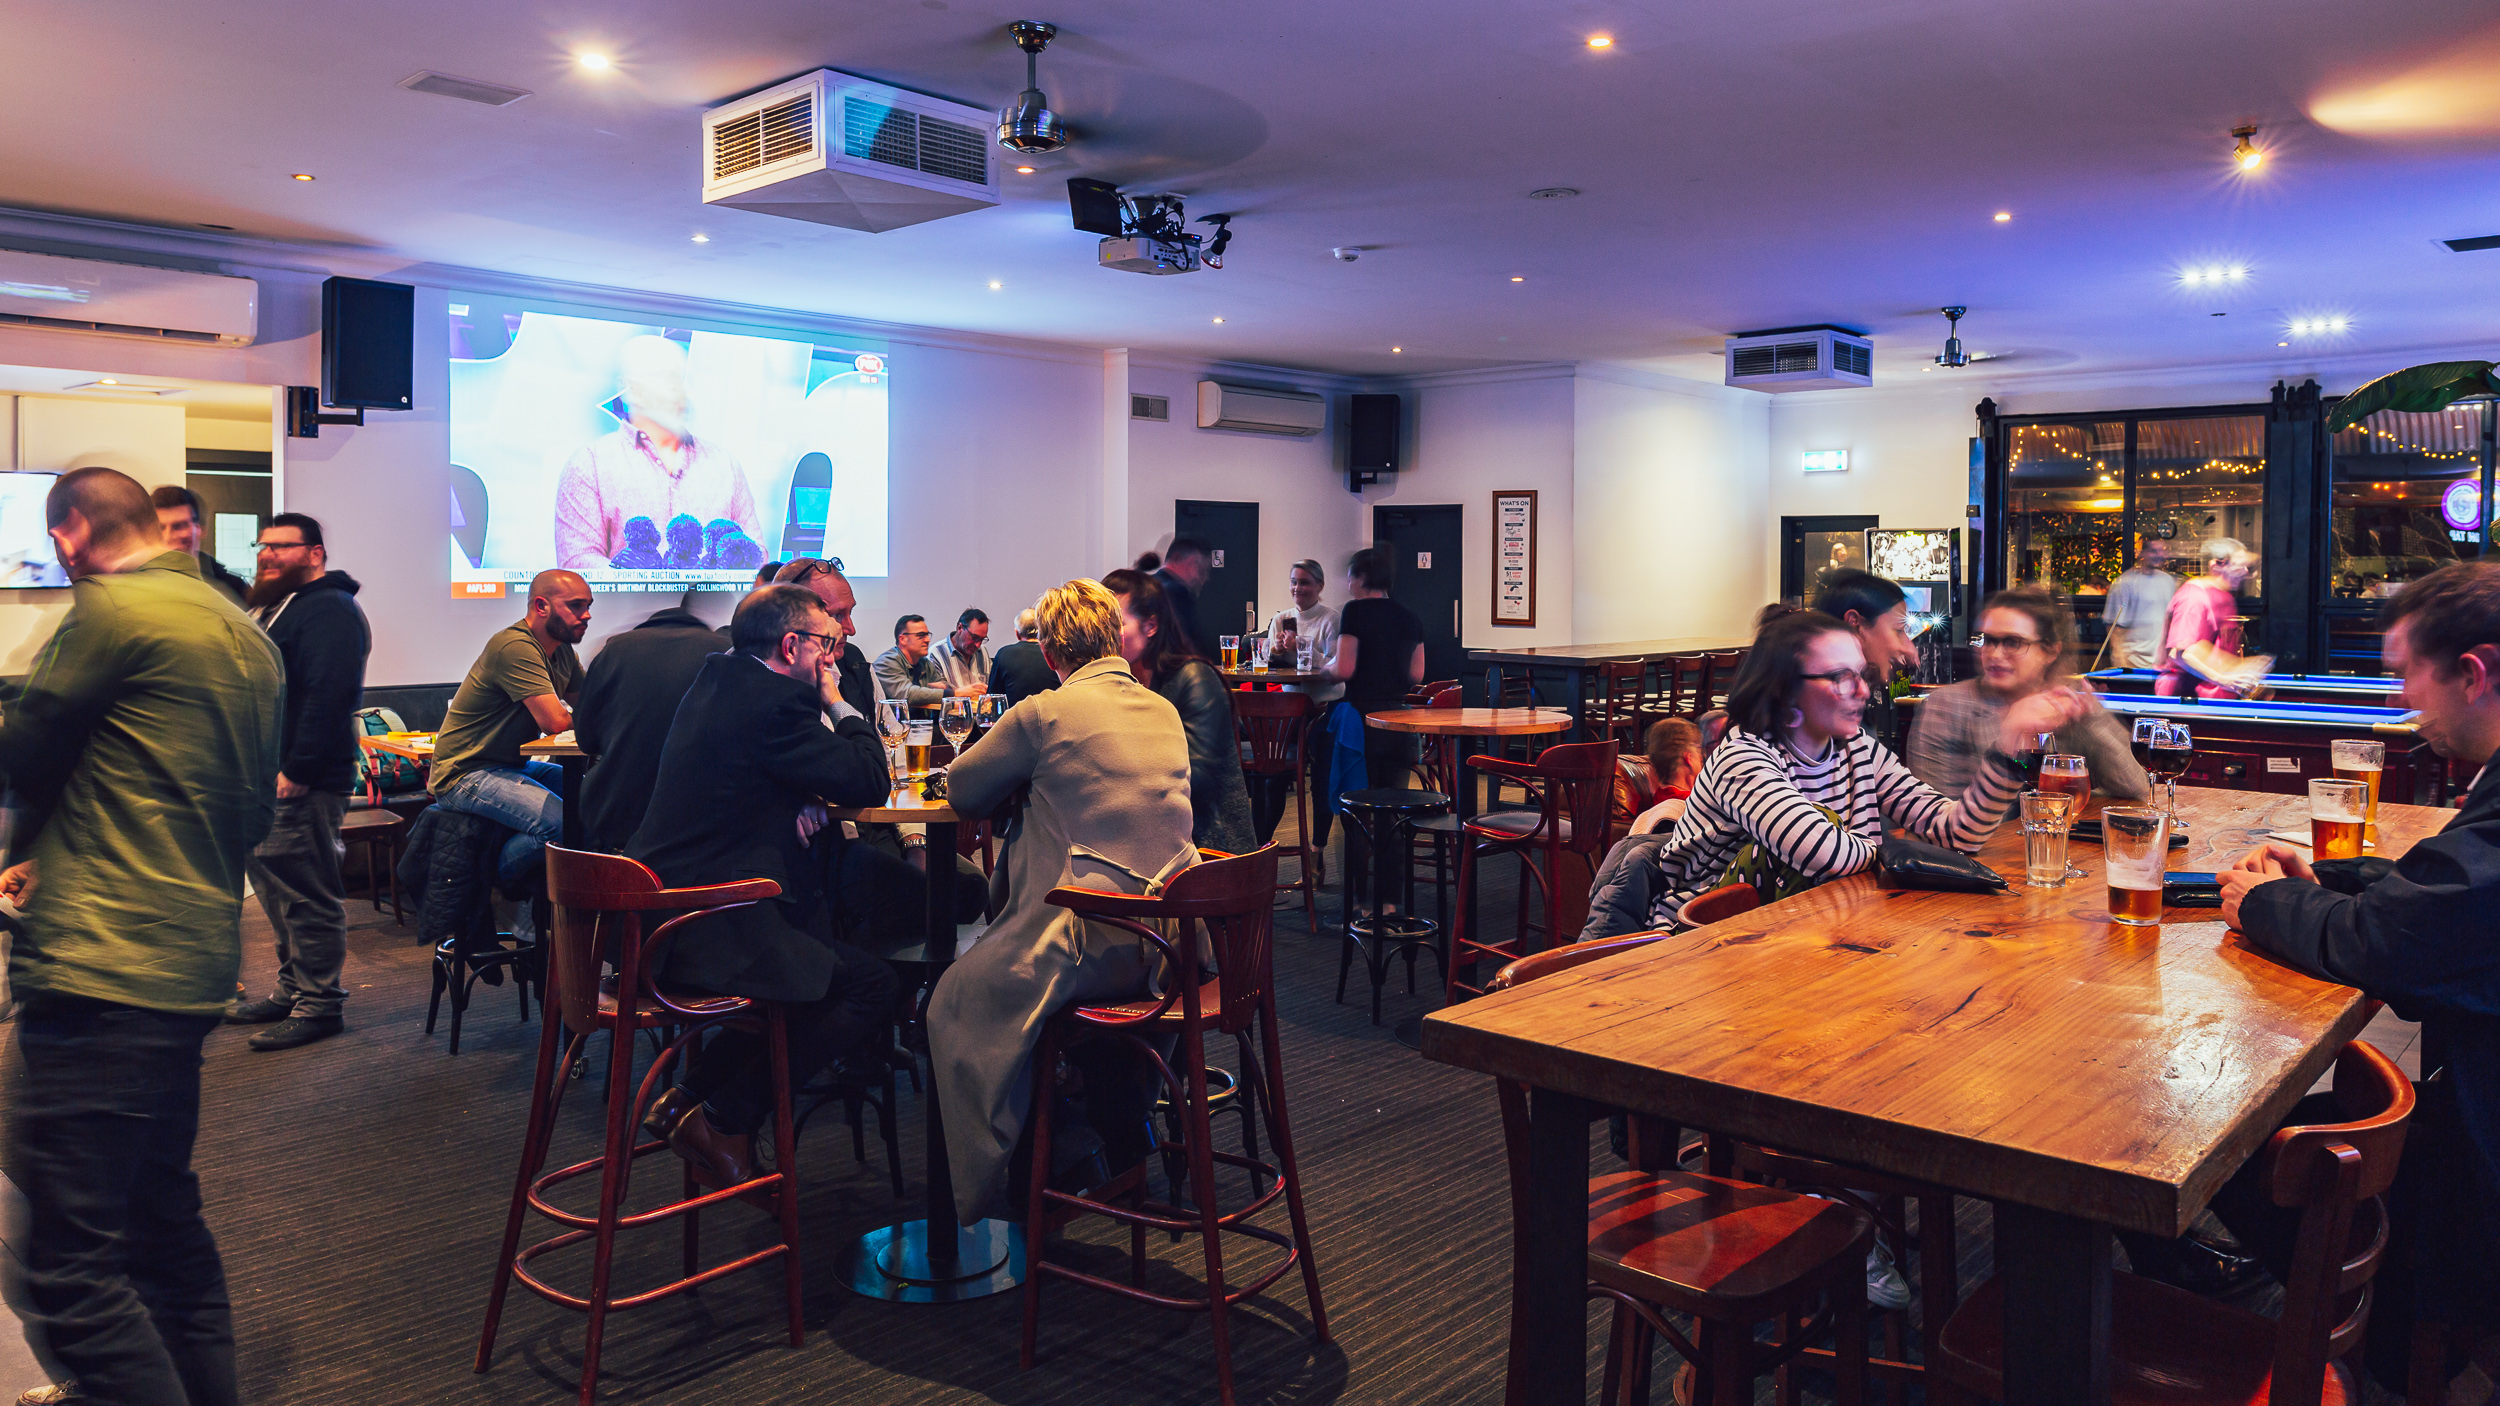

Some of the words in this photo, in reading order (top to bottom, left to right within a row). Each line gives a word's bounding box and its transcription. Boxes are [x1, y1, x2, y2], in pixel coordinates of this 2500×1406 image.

[613, 571, 648, 580] SPORTING
[651, 571, 680, 580] AUCTION
[617, 583, 647, 593] BIRTHDAY
[647, 583, 689, 593] BLOCKBUSTER
[696, 583, 737, 592] COLLINGWOOD
